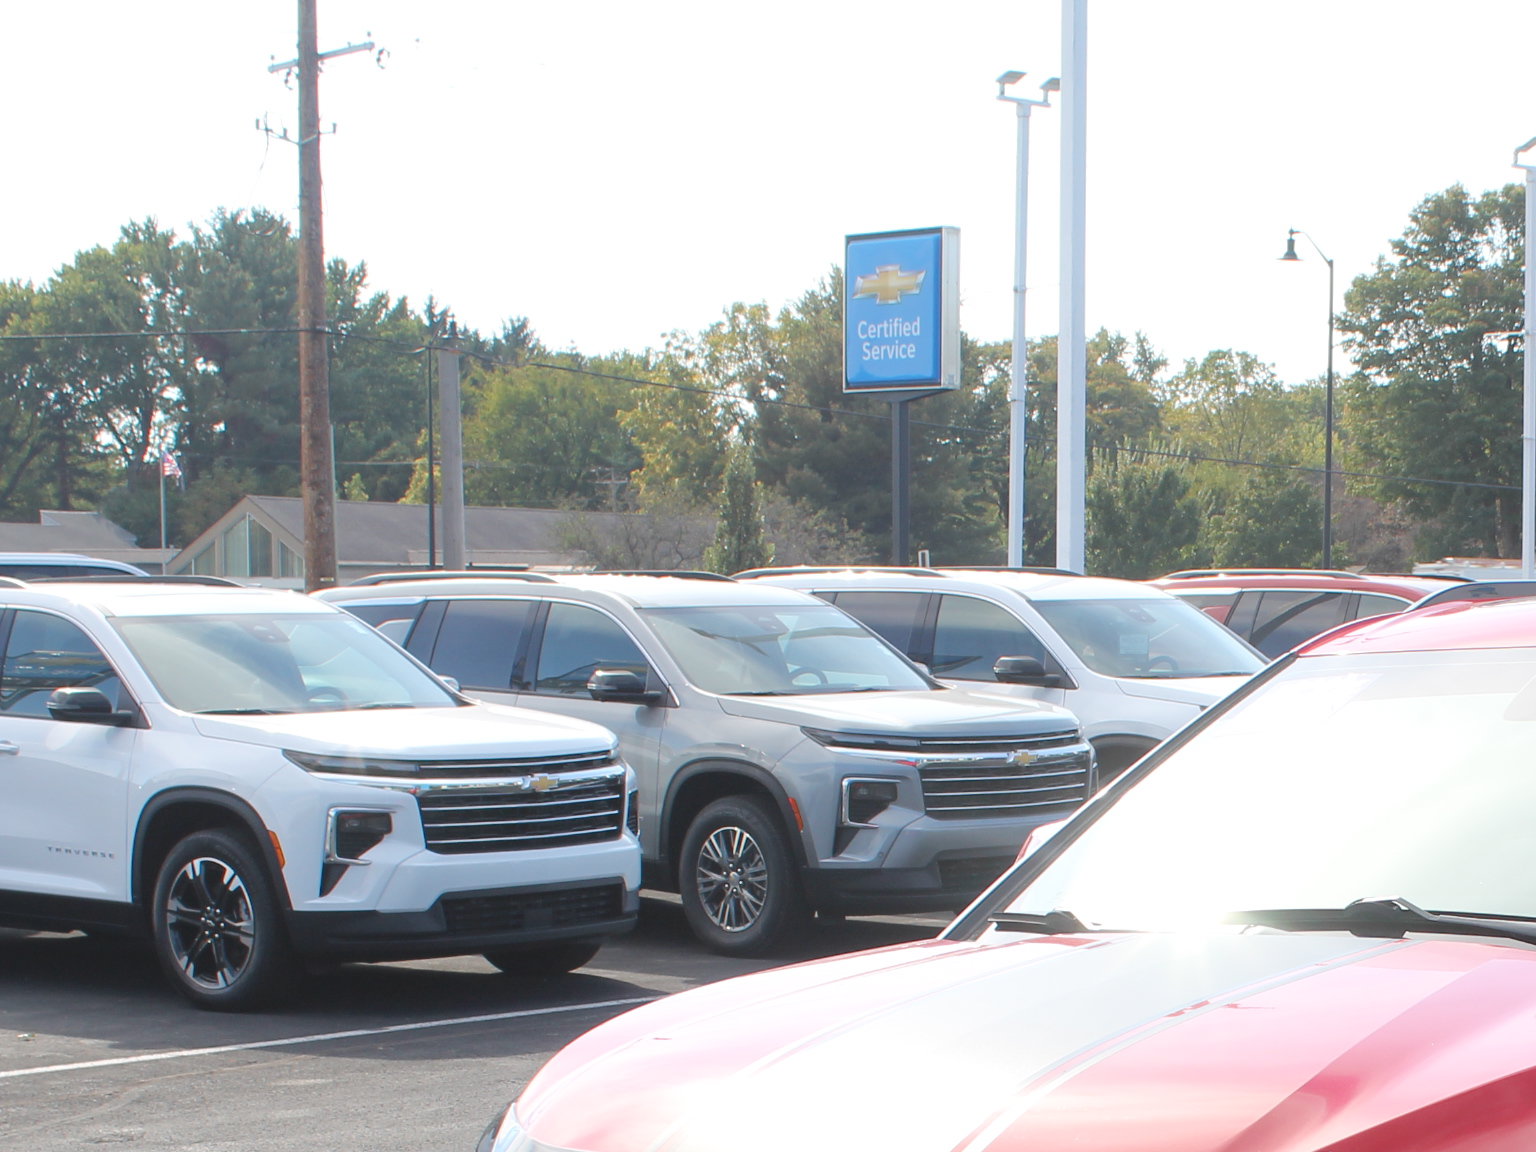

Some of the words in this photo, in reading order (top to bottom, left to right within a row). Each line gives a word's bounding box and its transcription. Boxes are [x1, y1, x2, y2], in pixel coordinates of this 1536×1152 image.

[857, 316, 920, 339] Certified
[862, 341, 916, 361] Service
[47, 846, 115, 859] TRAVERSE
